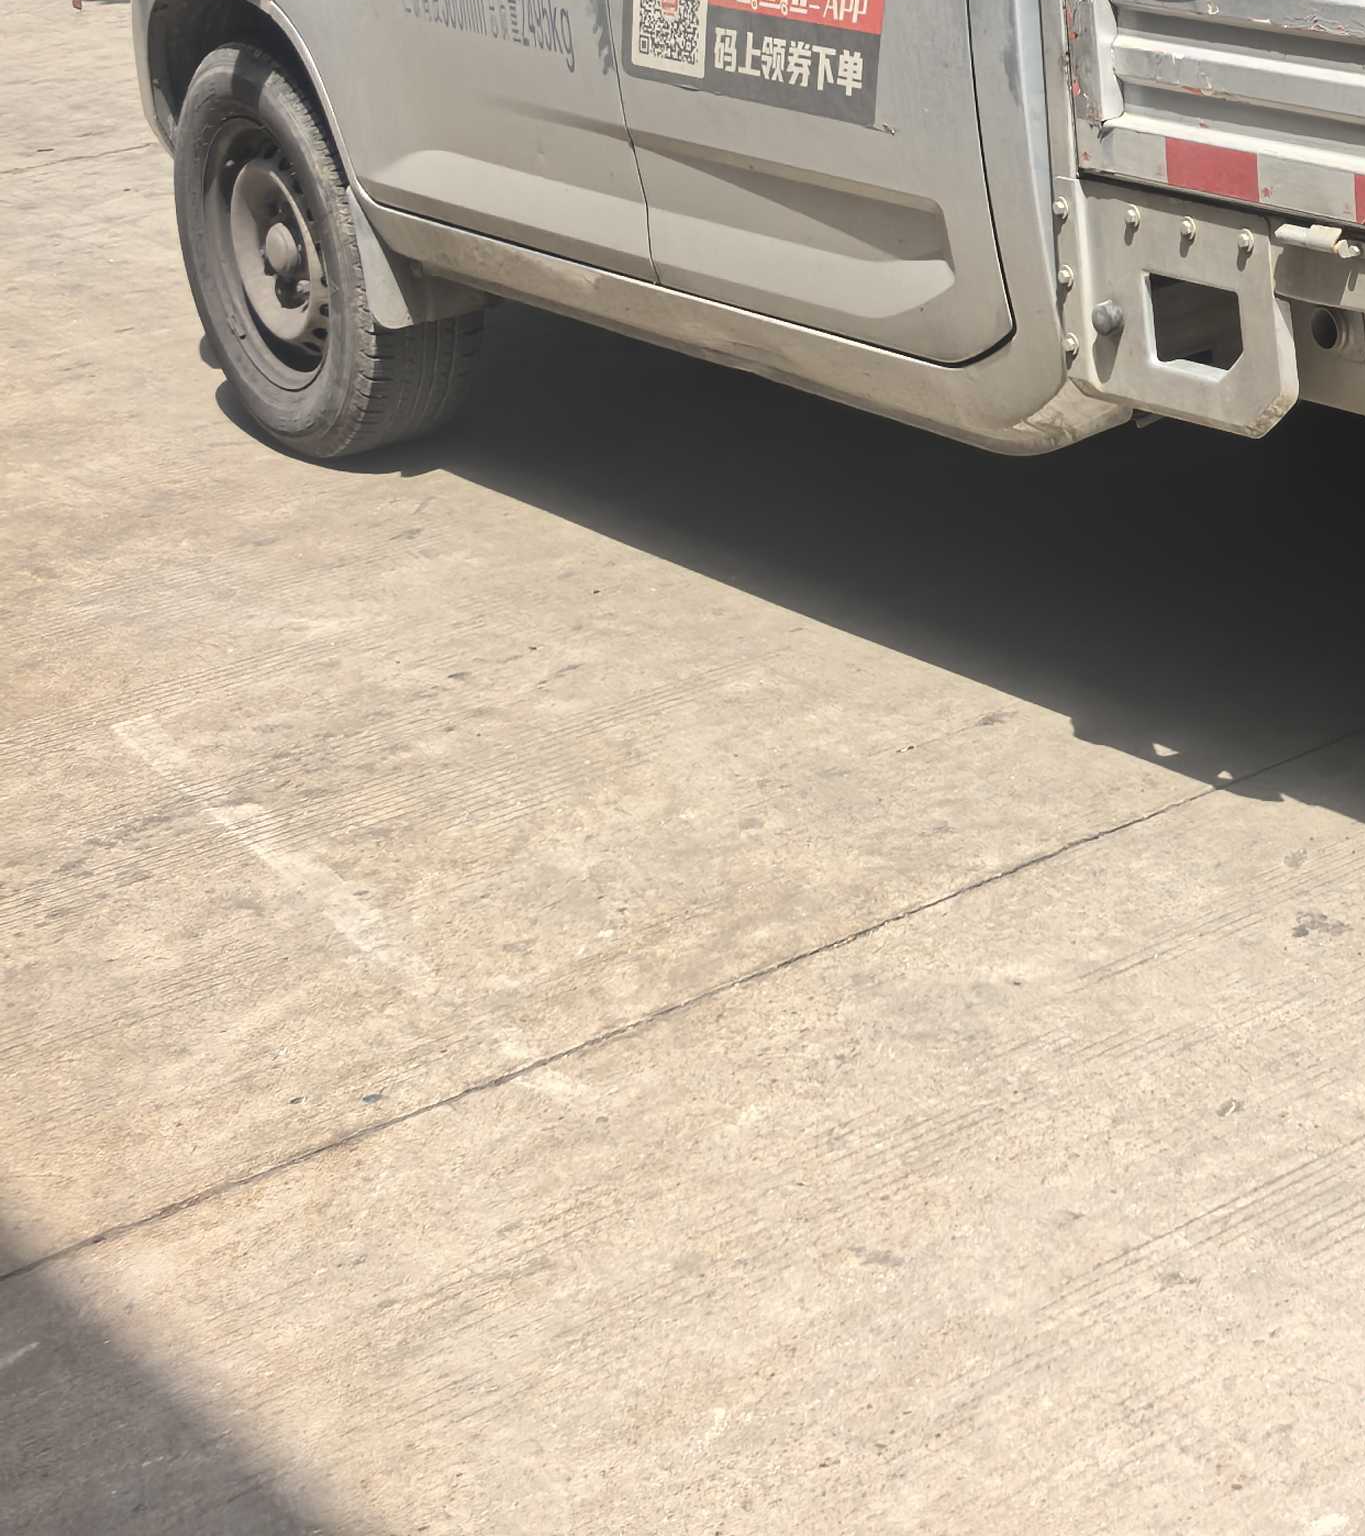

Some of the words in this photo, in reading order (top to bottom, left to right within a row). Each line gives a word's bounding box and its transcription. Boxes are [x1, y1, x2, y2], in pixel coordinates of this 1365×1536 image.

[714, 26, 864, 96] 码上领券下单
